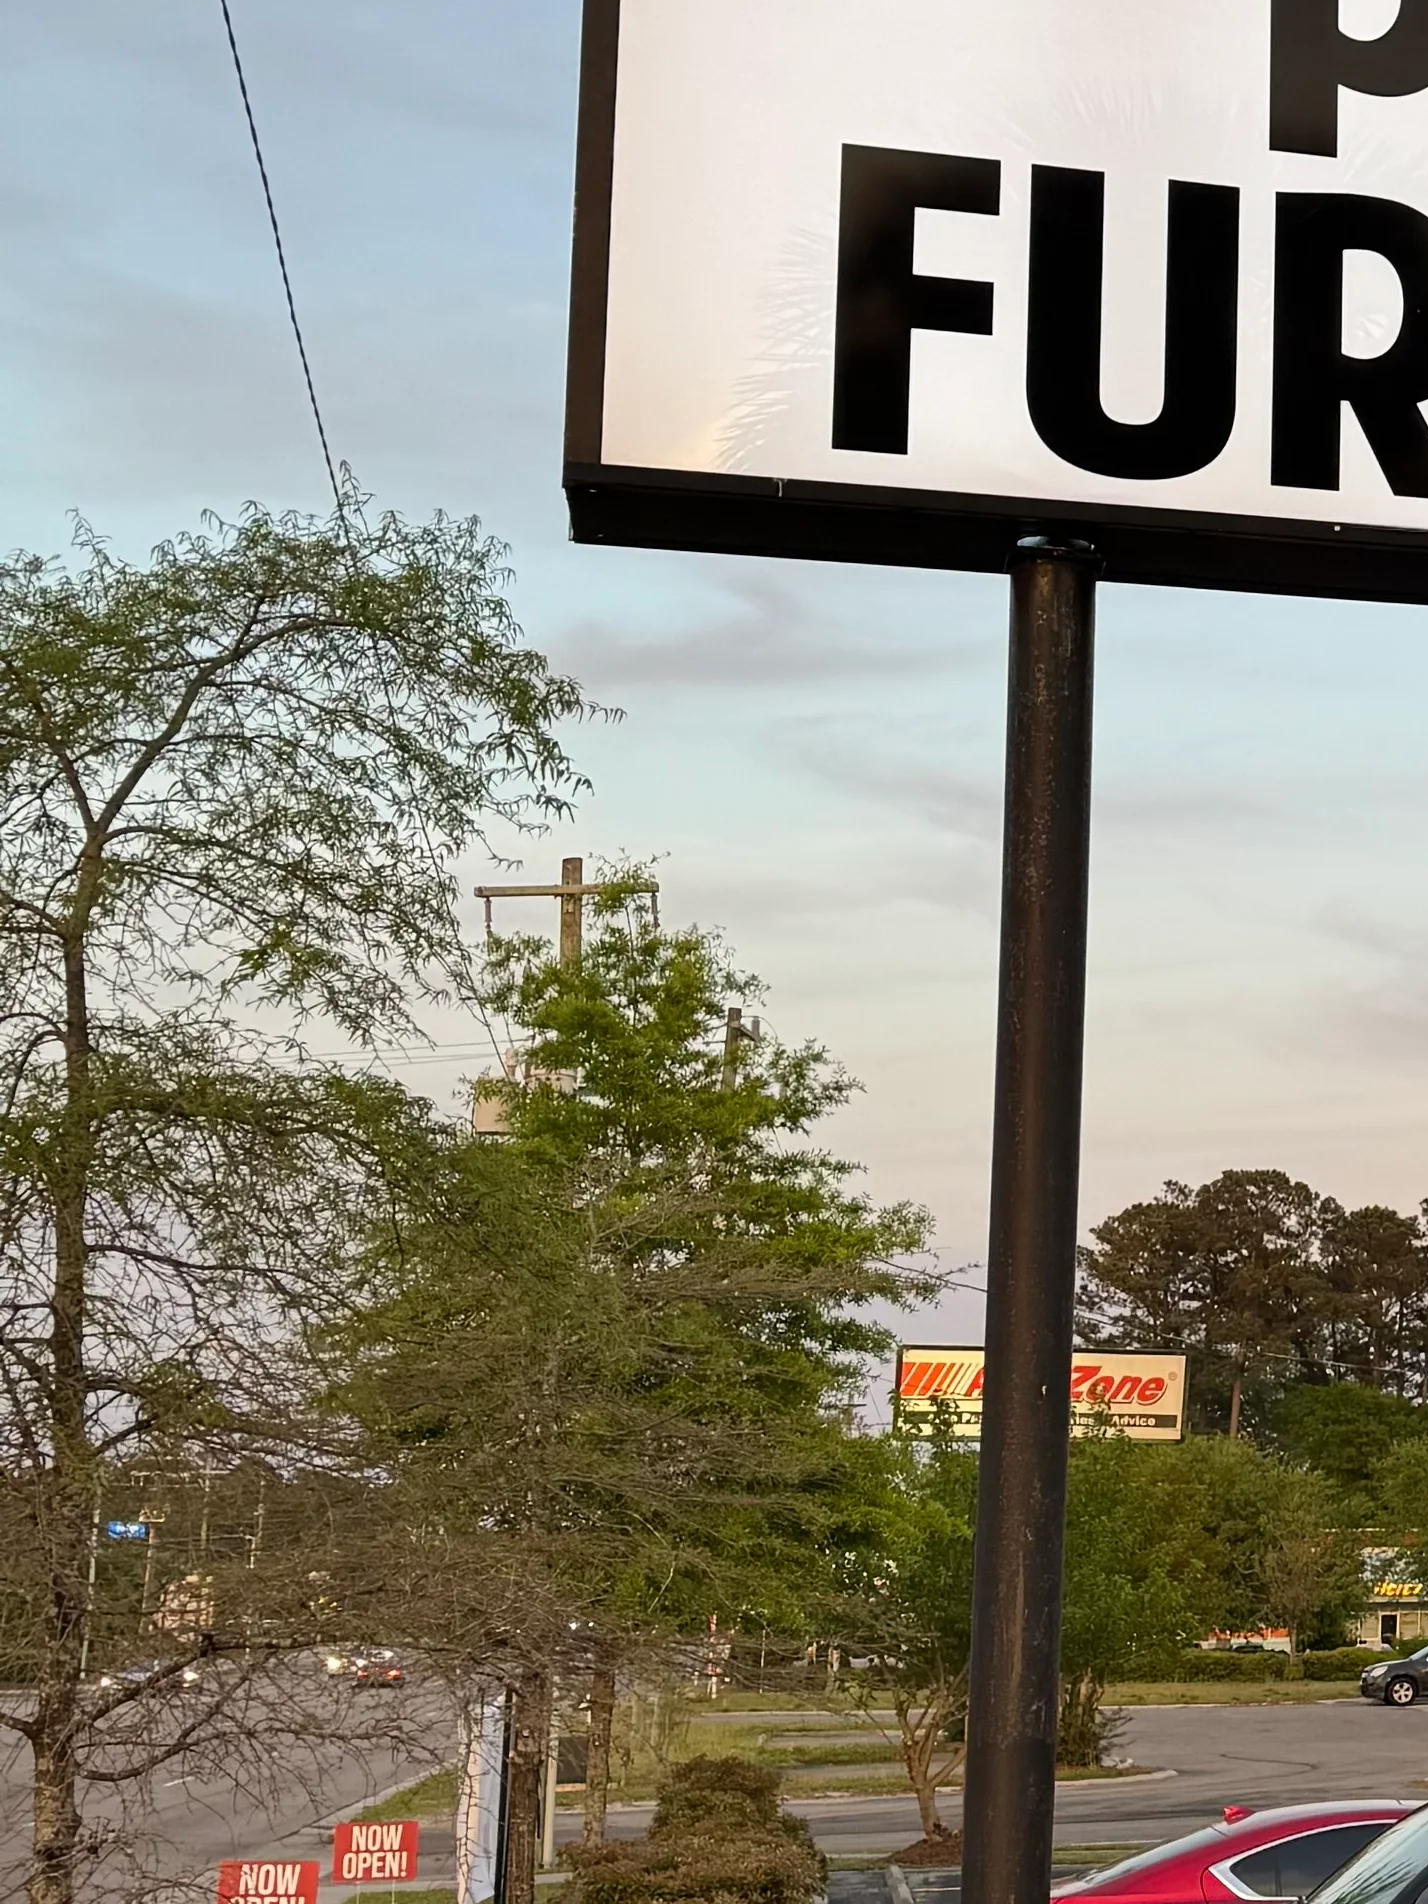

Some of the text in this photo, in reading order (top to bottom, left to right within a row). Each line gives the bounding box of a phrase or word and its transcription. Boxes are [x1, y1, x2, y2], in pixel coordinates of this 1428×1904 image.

[351, 1823, 404, 1852] NOW
[238, 1863, 302, 1896] NOW
[341, 1851, 408, 1880] OPEN!
